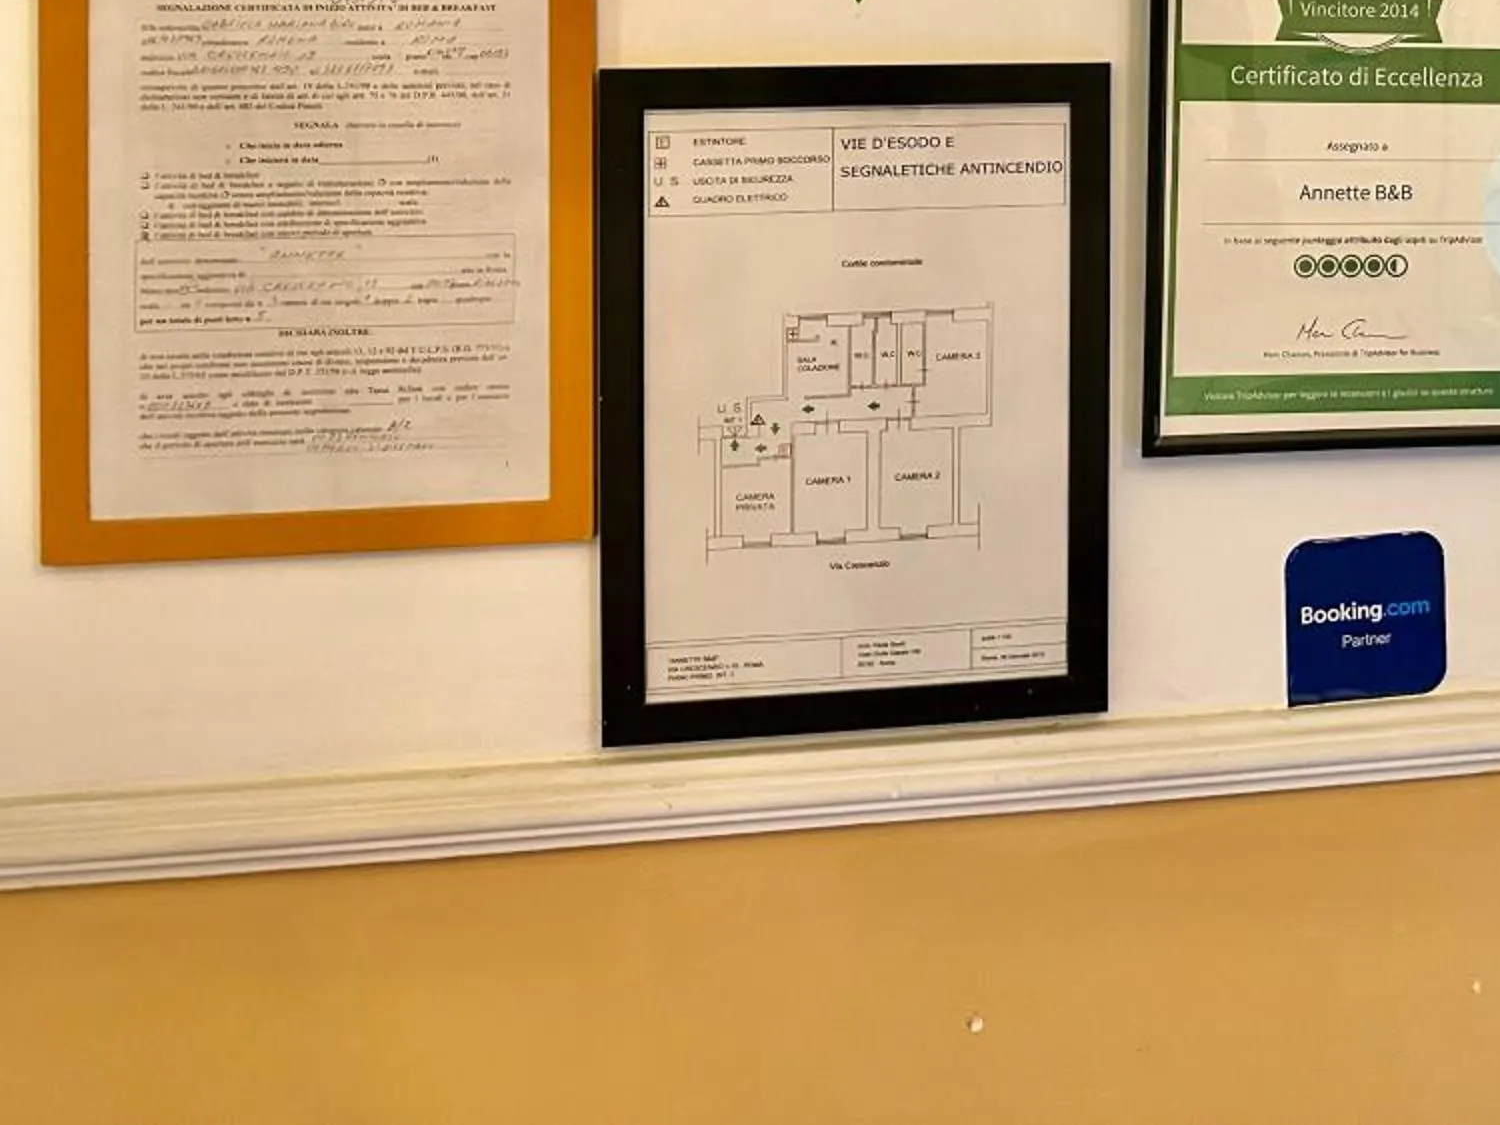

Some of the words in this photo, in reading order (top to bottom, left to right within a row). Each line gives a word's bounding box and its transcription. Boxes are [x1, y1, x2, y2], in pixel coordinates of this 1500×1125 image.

[1301, 1, 1377, 18] Vincitore
[1380, 2, 1419, 18] 2014
[1231, 65, 1342, 87] Certificato
[1350, 65, 1369, 87] di
[1375, 66, 1483, 88] Eccellenza
[840, 138, 866, 150] VIE
[872, 137, 941, 150] D'ESODO
[945, 137, 955, 148] E
[840, 163, 955, 178] SEGNALETICHE
[960, 160, 1064, 175] ANTINCENDIO
[1299, 184, 1371, 201] Annette
[1375, 184, 1413, 201] B&B
[1301, 599, 1431, 626] Booking.com
[1341, 632, 1392, 650] Partner
